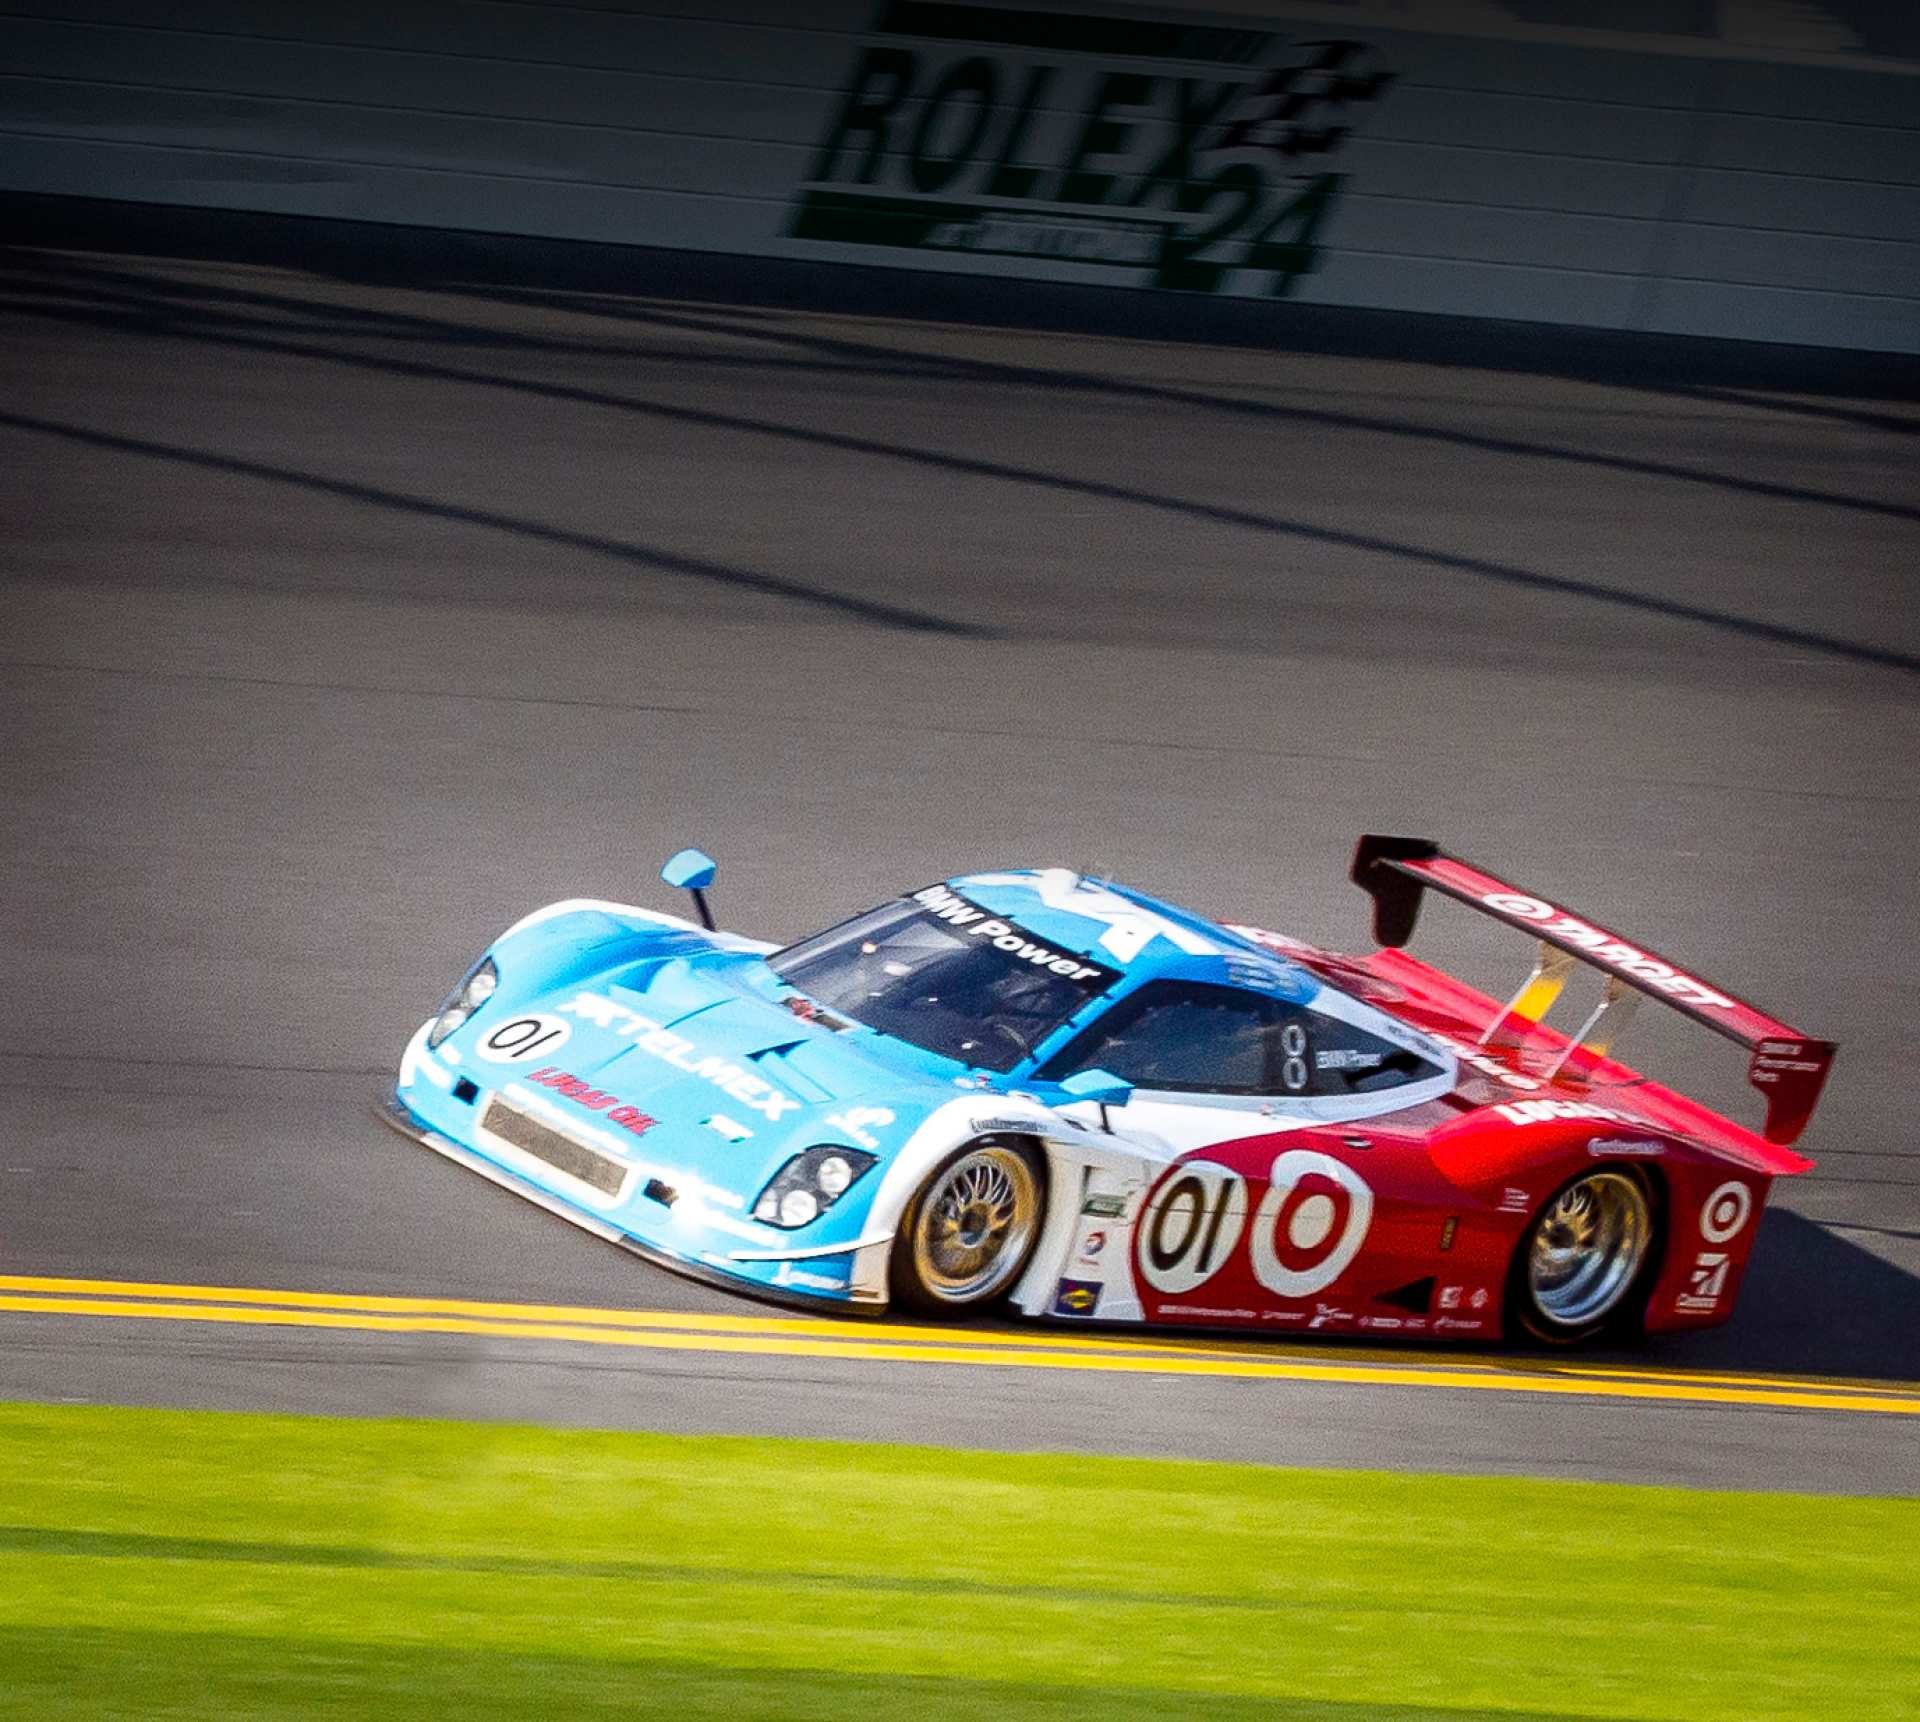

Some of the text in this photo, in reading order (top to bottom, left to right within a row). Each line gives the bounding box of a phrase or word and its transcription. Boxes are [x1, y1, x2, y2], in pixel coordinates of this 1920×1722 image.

[812, 46, 1248, 212] ROLEX
[1154, 163, 1338, 297] 24
[912, 884, 1102, 980] BMW Power
[1541, 917, 1735, 1009] TARGET
[488, 1019, 562, 1058] 01
[1149, 1175, 1236, 1274] 01
